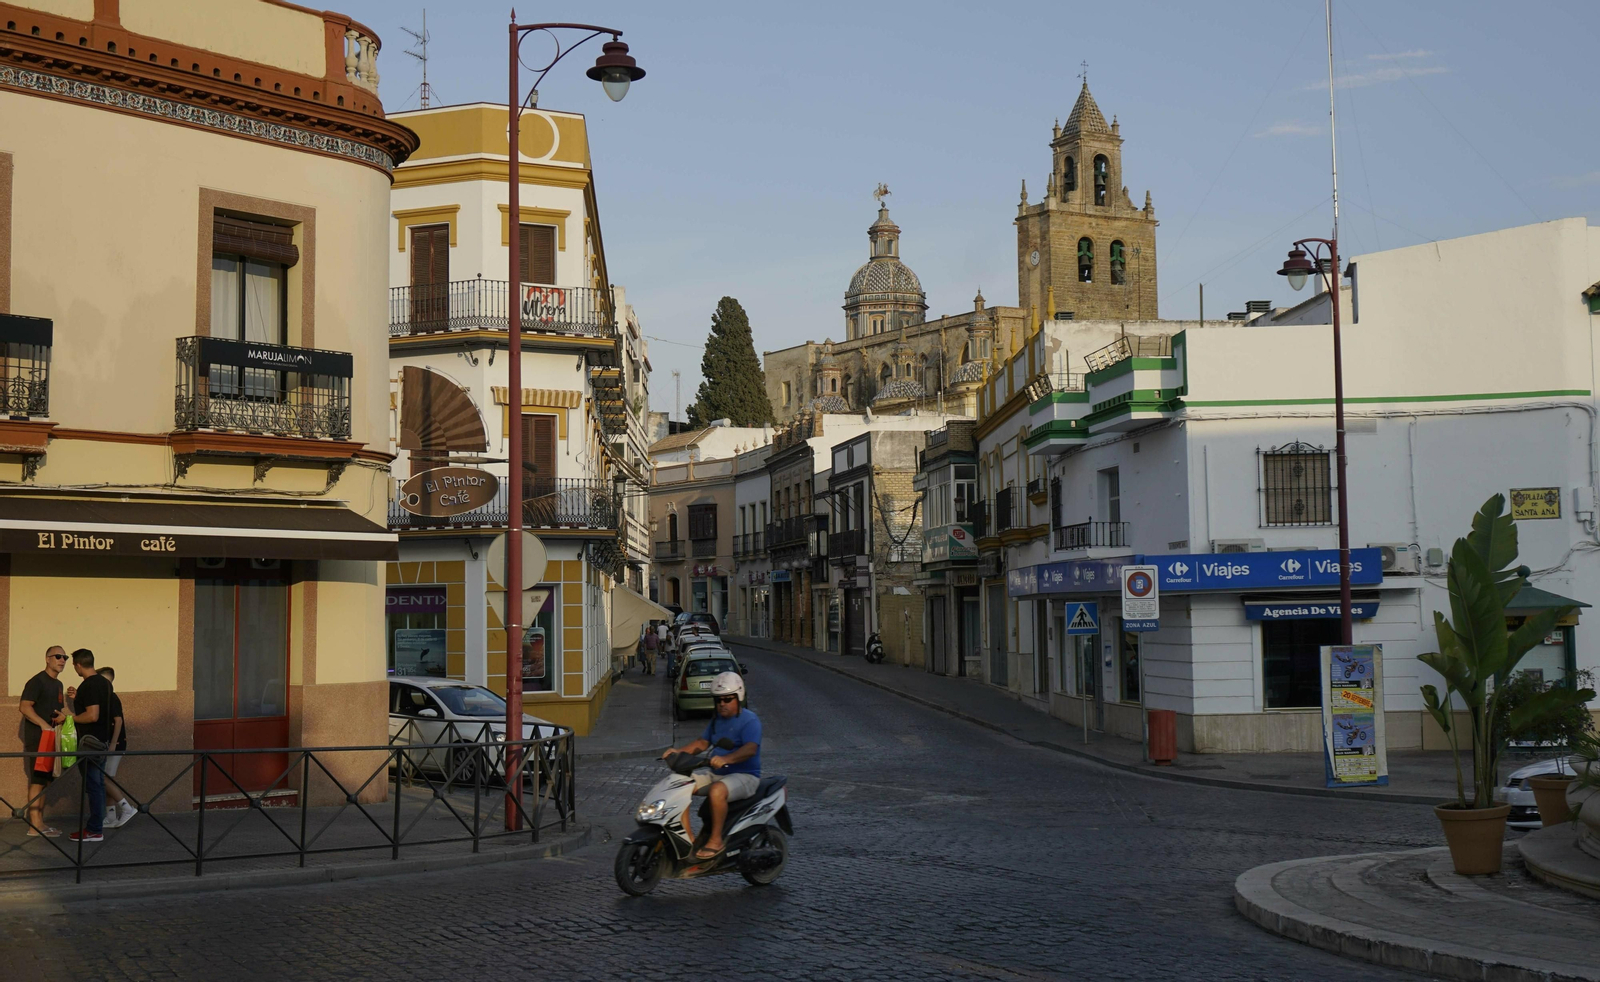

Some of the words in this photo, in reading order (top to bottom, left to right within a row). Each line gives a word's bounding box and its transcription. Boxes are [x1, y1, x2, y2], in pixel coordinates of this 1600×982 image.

[425, 480, 440, 493] El
[442, 475, 486, 489] Pintor
[440, 489, 471, 506] Café
[1525, 493, 1544, 501] PLAZA
[1515, 509, 1538, 517] SANTA
[1541, 508, 1556, 516] ANA
[37, 532, 55, 549] El
[61, 533, 114, 550] Pintor
[140, 536, 176, 552] café
[1202, 562, 1250, 579] Viajes
[1315, 559, 1363, 576] Viaes
[1263, 606, 1309, 619] Agencia
[1310, 606, 1326, 615] De
[1327, 606, 1363, 615] Vies
